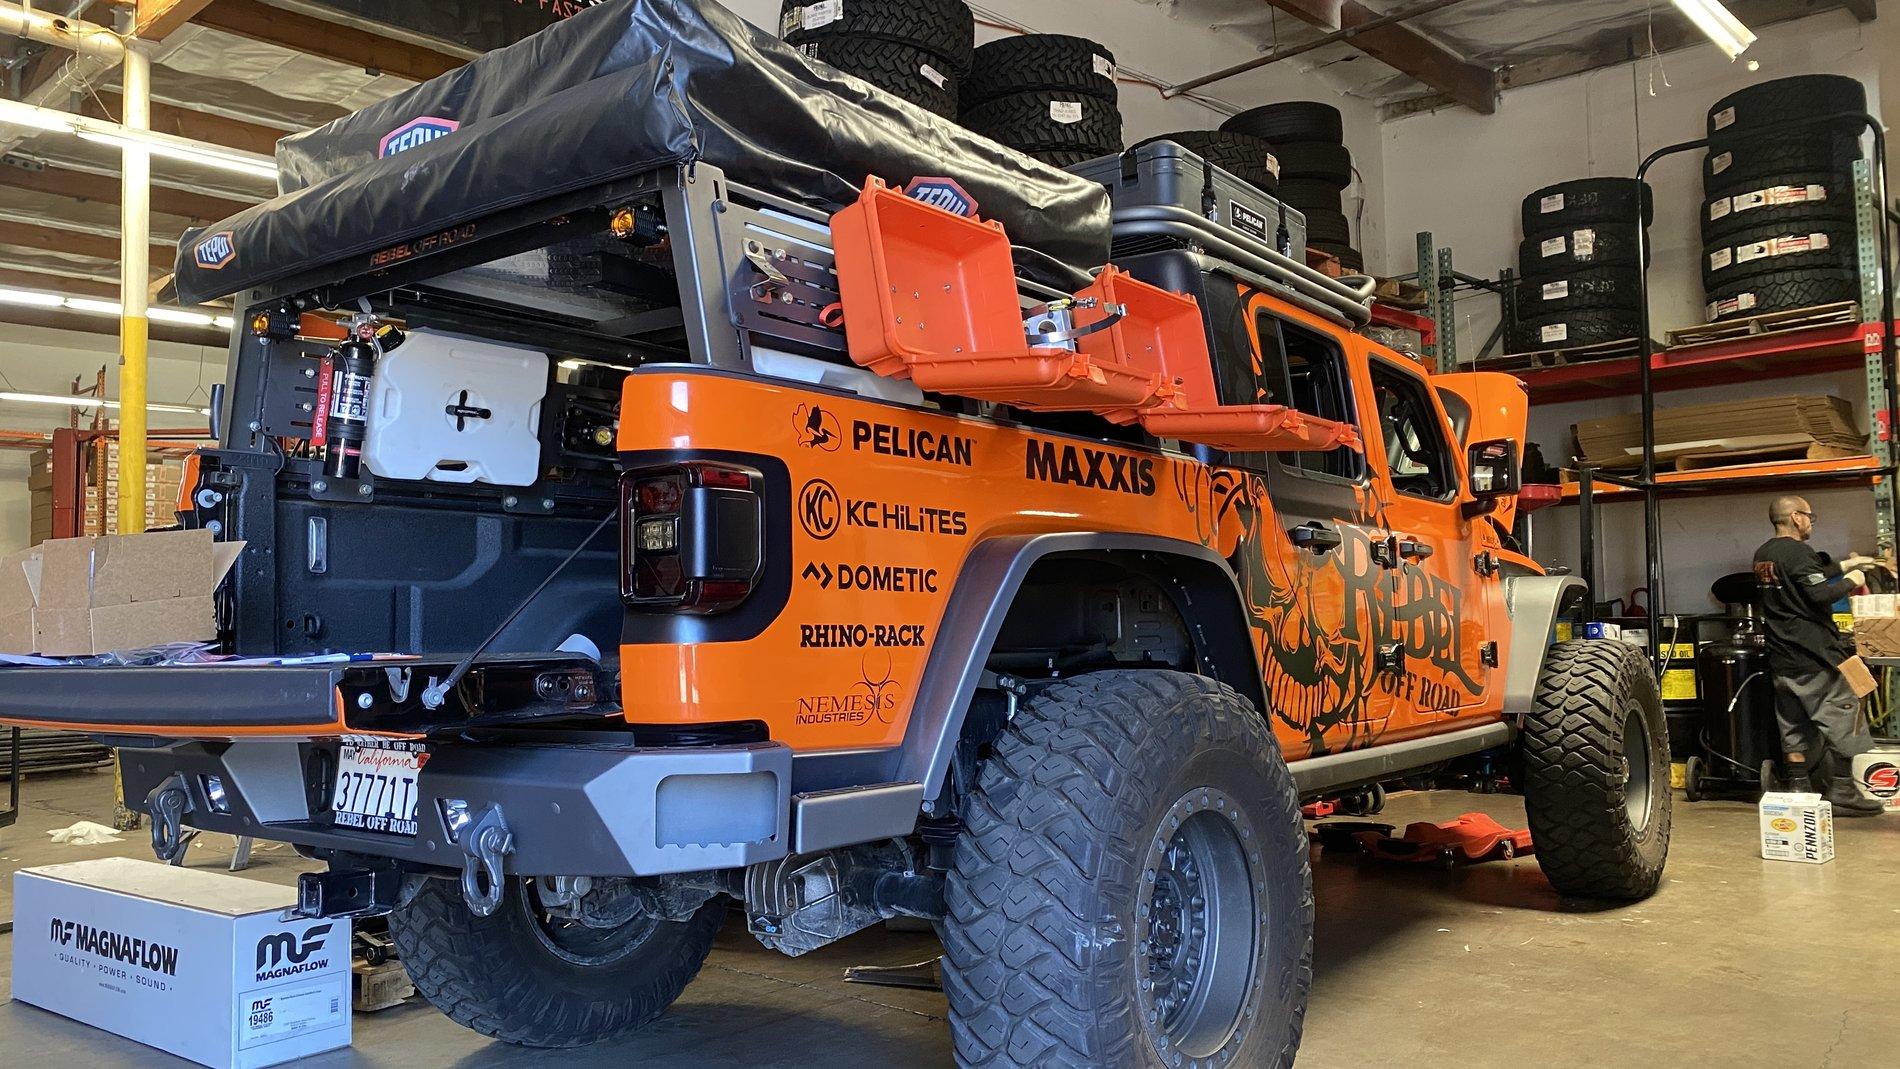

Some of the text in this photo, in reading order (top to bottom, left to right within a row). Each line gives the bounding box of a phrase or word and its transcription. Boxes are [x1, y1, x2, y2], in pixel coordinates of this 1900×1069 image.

[1242, 212, 1264, 229] PELICAN
[199, 236, 229, 262] TEPUI
[370, 244, 412, 266] REBEL
[315, 372, 329, 438] PULL TO RELEASE
[852, 420, 972, 466] PELICAN
[1026, 438, 1156, 496] MAXXIS
[805, 486, 833, 532] KC
[846, 499, 967, 536] KC HiLiTES
[838, 564, 938, 593] DOMETIC
[800, 624, 925, 647] RHINO-RACK
[796, 694, 895, 714] NEMESIS
[1380, 671, 1461, 717] OFF ROAD
[796, 712, 865, 725] INDUSTRIES
[393, 742, 407, 751] OFF
[357, 748, 413, 773] California
[334, 811, 418, 835] REBEL OFF ROAD
[1803, 810, 1818, 861] PENNZOIL
[76, 923, 179, 976] MAGNAFLOW
[59, 952, 91, 968] QUALITY
[98, 964, 127, 980] POWER
[135, 974, 167, 991] SOUND
[256, 959, 329, 982] MAGNAFLOW
[248, 1011, 274, 1027] 19486
